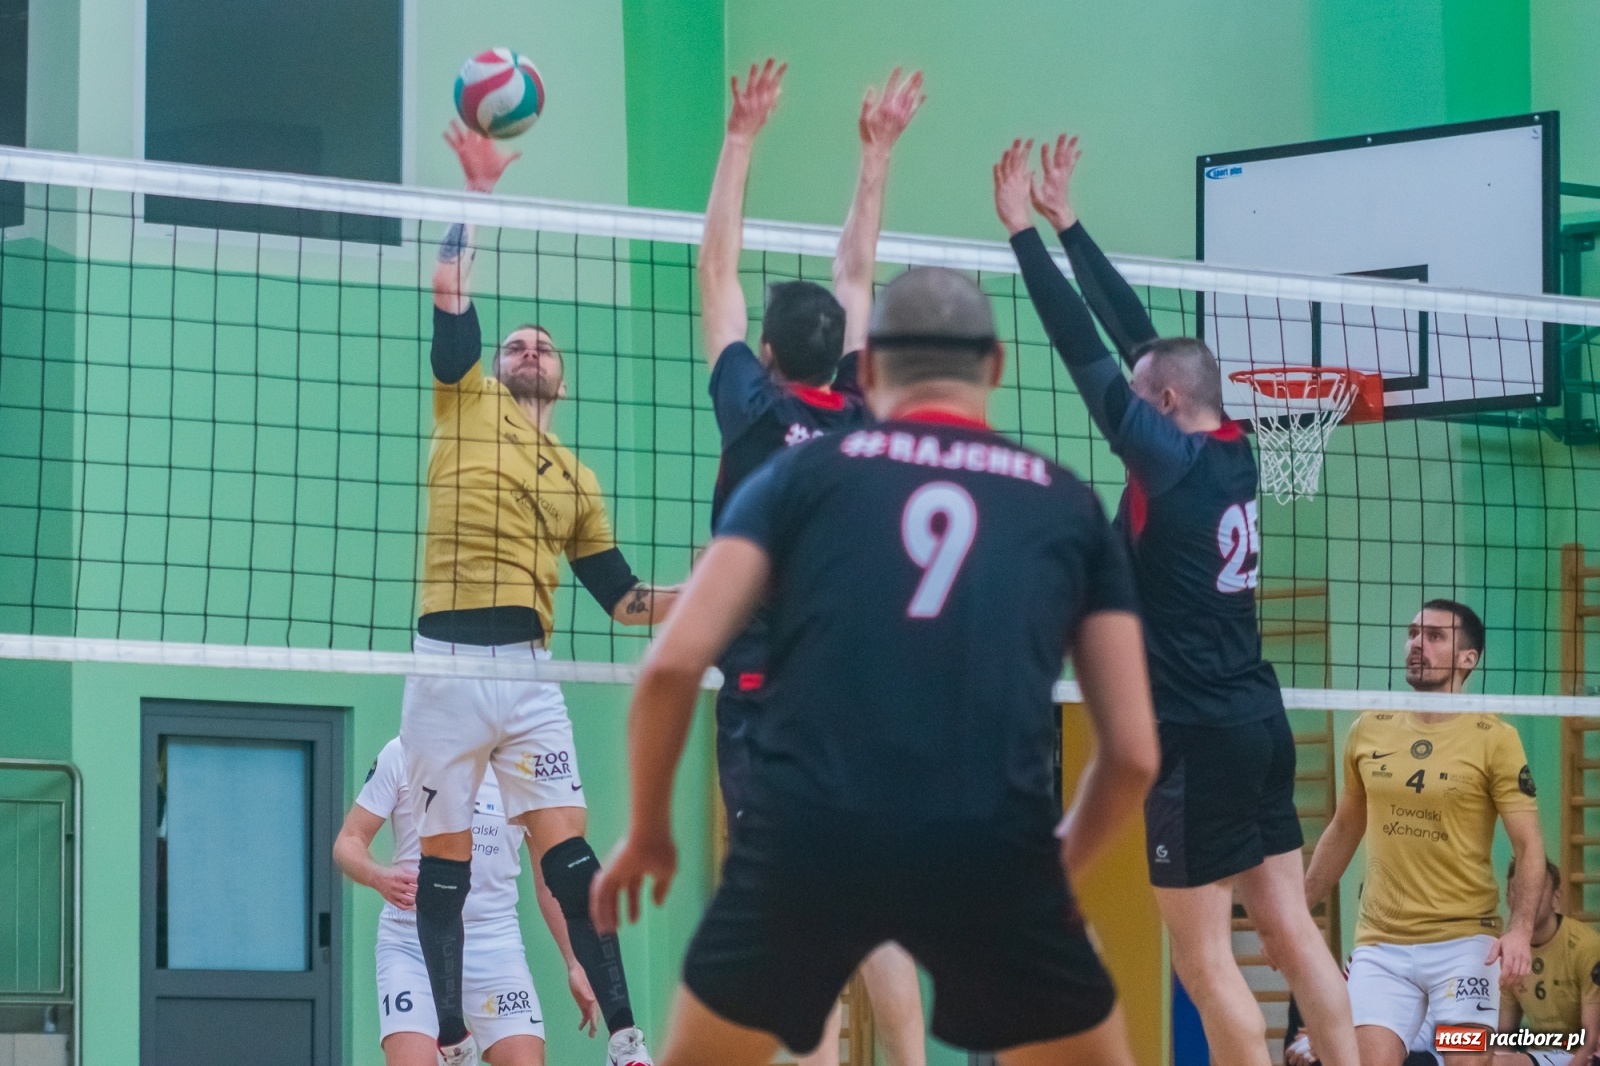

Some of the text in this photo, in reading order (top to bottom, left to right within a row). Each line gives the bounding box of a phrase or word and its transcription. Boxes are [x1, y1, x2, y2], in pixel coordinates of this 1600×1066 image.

[901, 480, 978, 619] 9
[533, 751, 569, 767] ZOO
[535, 763, 571, 778] MAR
[1405, 769, 1426, 794] 4
[422, 785, 438, 813] 7
[1390, 804, 1442, 822] Towalski
[471, 824, 499, 837] alski
[471, 842, 500, 856] ange
[1457, 977, 1490, 988] ZOO
[496, 991, 529, 1005] ZOO
[1456, 986, 1490, 998] MAR
[1535, 980, 1547, 1001] 6
[383, 991, 414, 1016] 16
[498, 1000, 531, 1015] MAR
